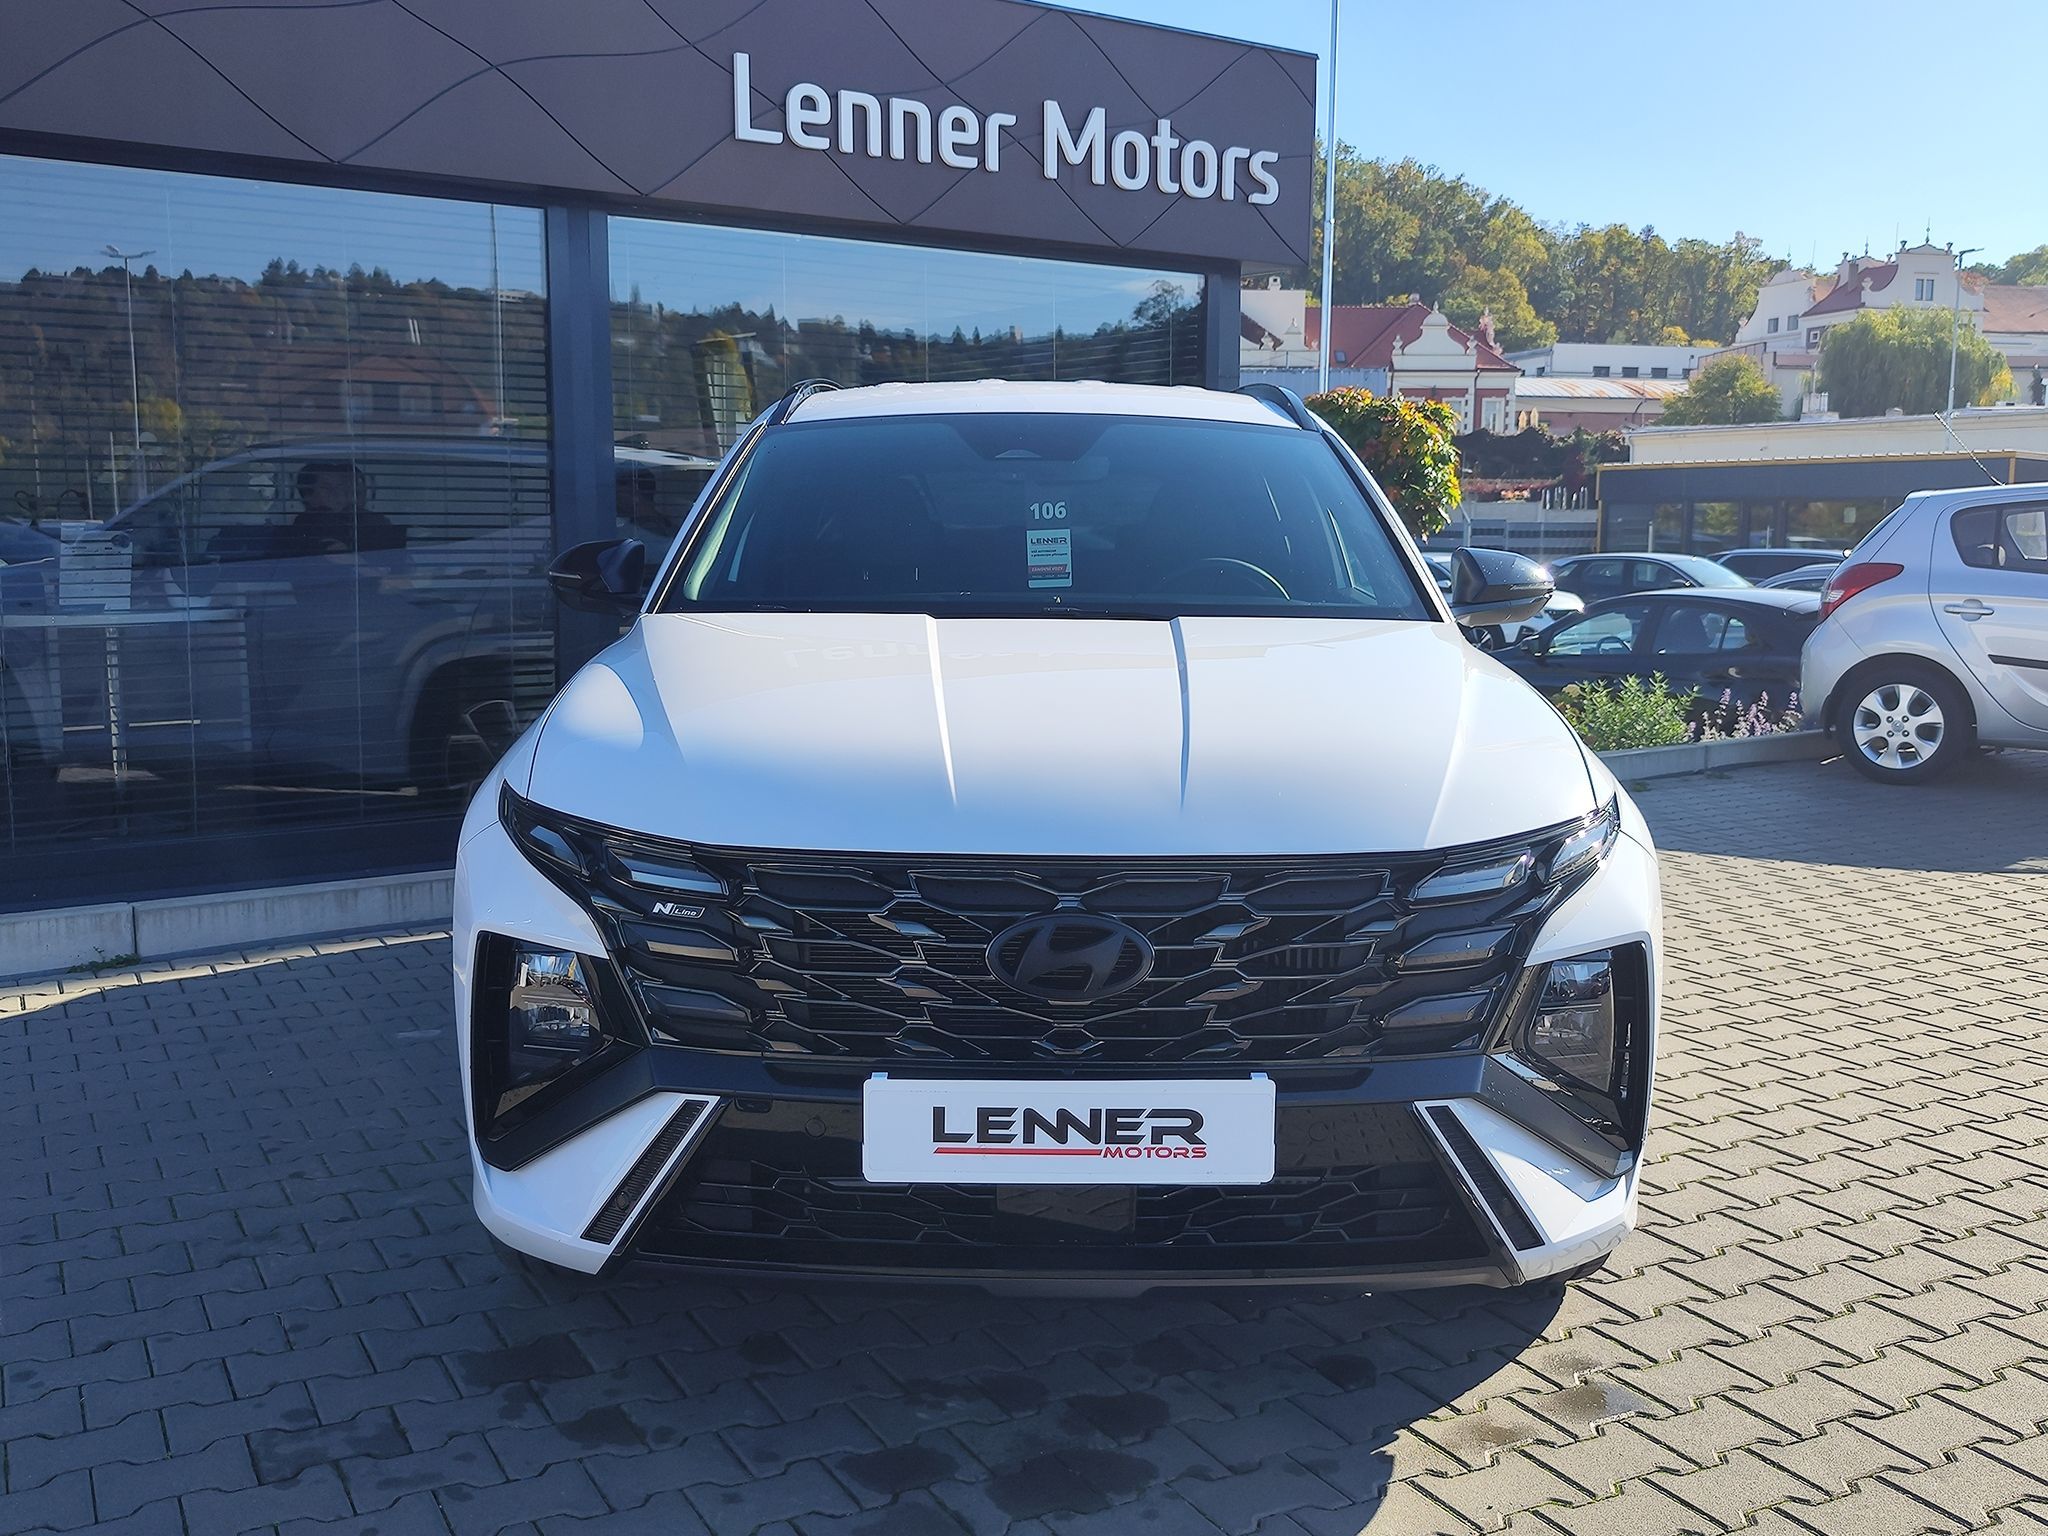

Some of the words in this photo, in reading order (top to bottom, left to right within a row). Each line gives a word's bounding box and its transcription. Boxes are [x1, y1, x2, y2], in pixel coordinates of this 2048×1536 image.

[733, 51, 1017, 173] Lenner
[1043, 99, 1280, 205] Motors
[1029, 501, 1067, 520] 106
[1030, 537, 1068, 545] LENNER
[675, 908, 698, 916] Line
[932, 1106, 1207, 1145] LENNER
[1103, 1146, 1208, 1158] MOTORS
